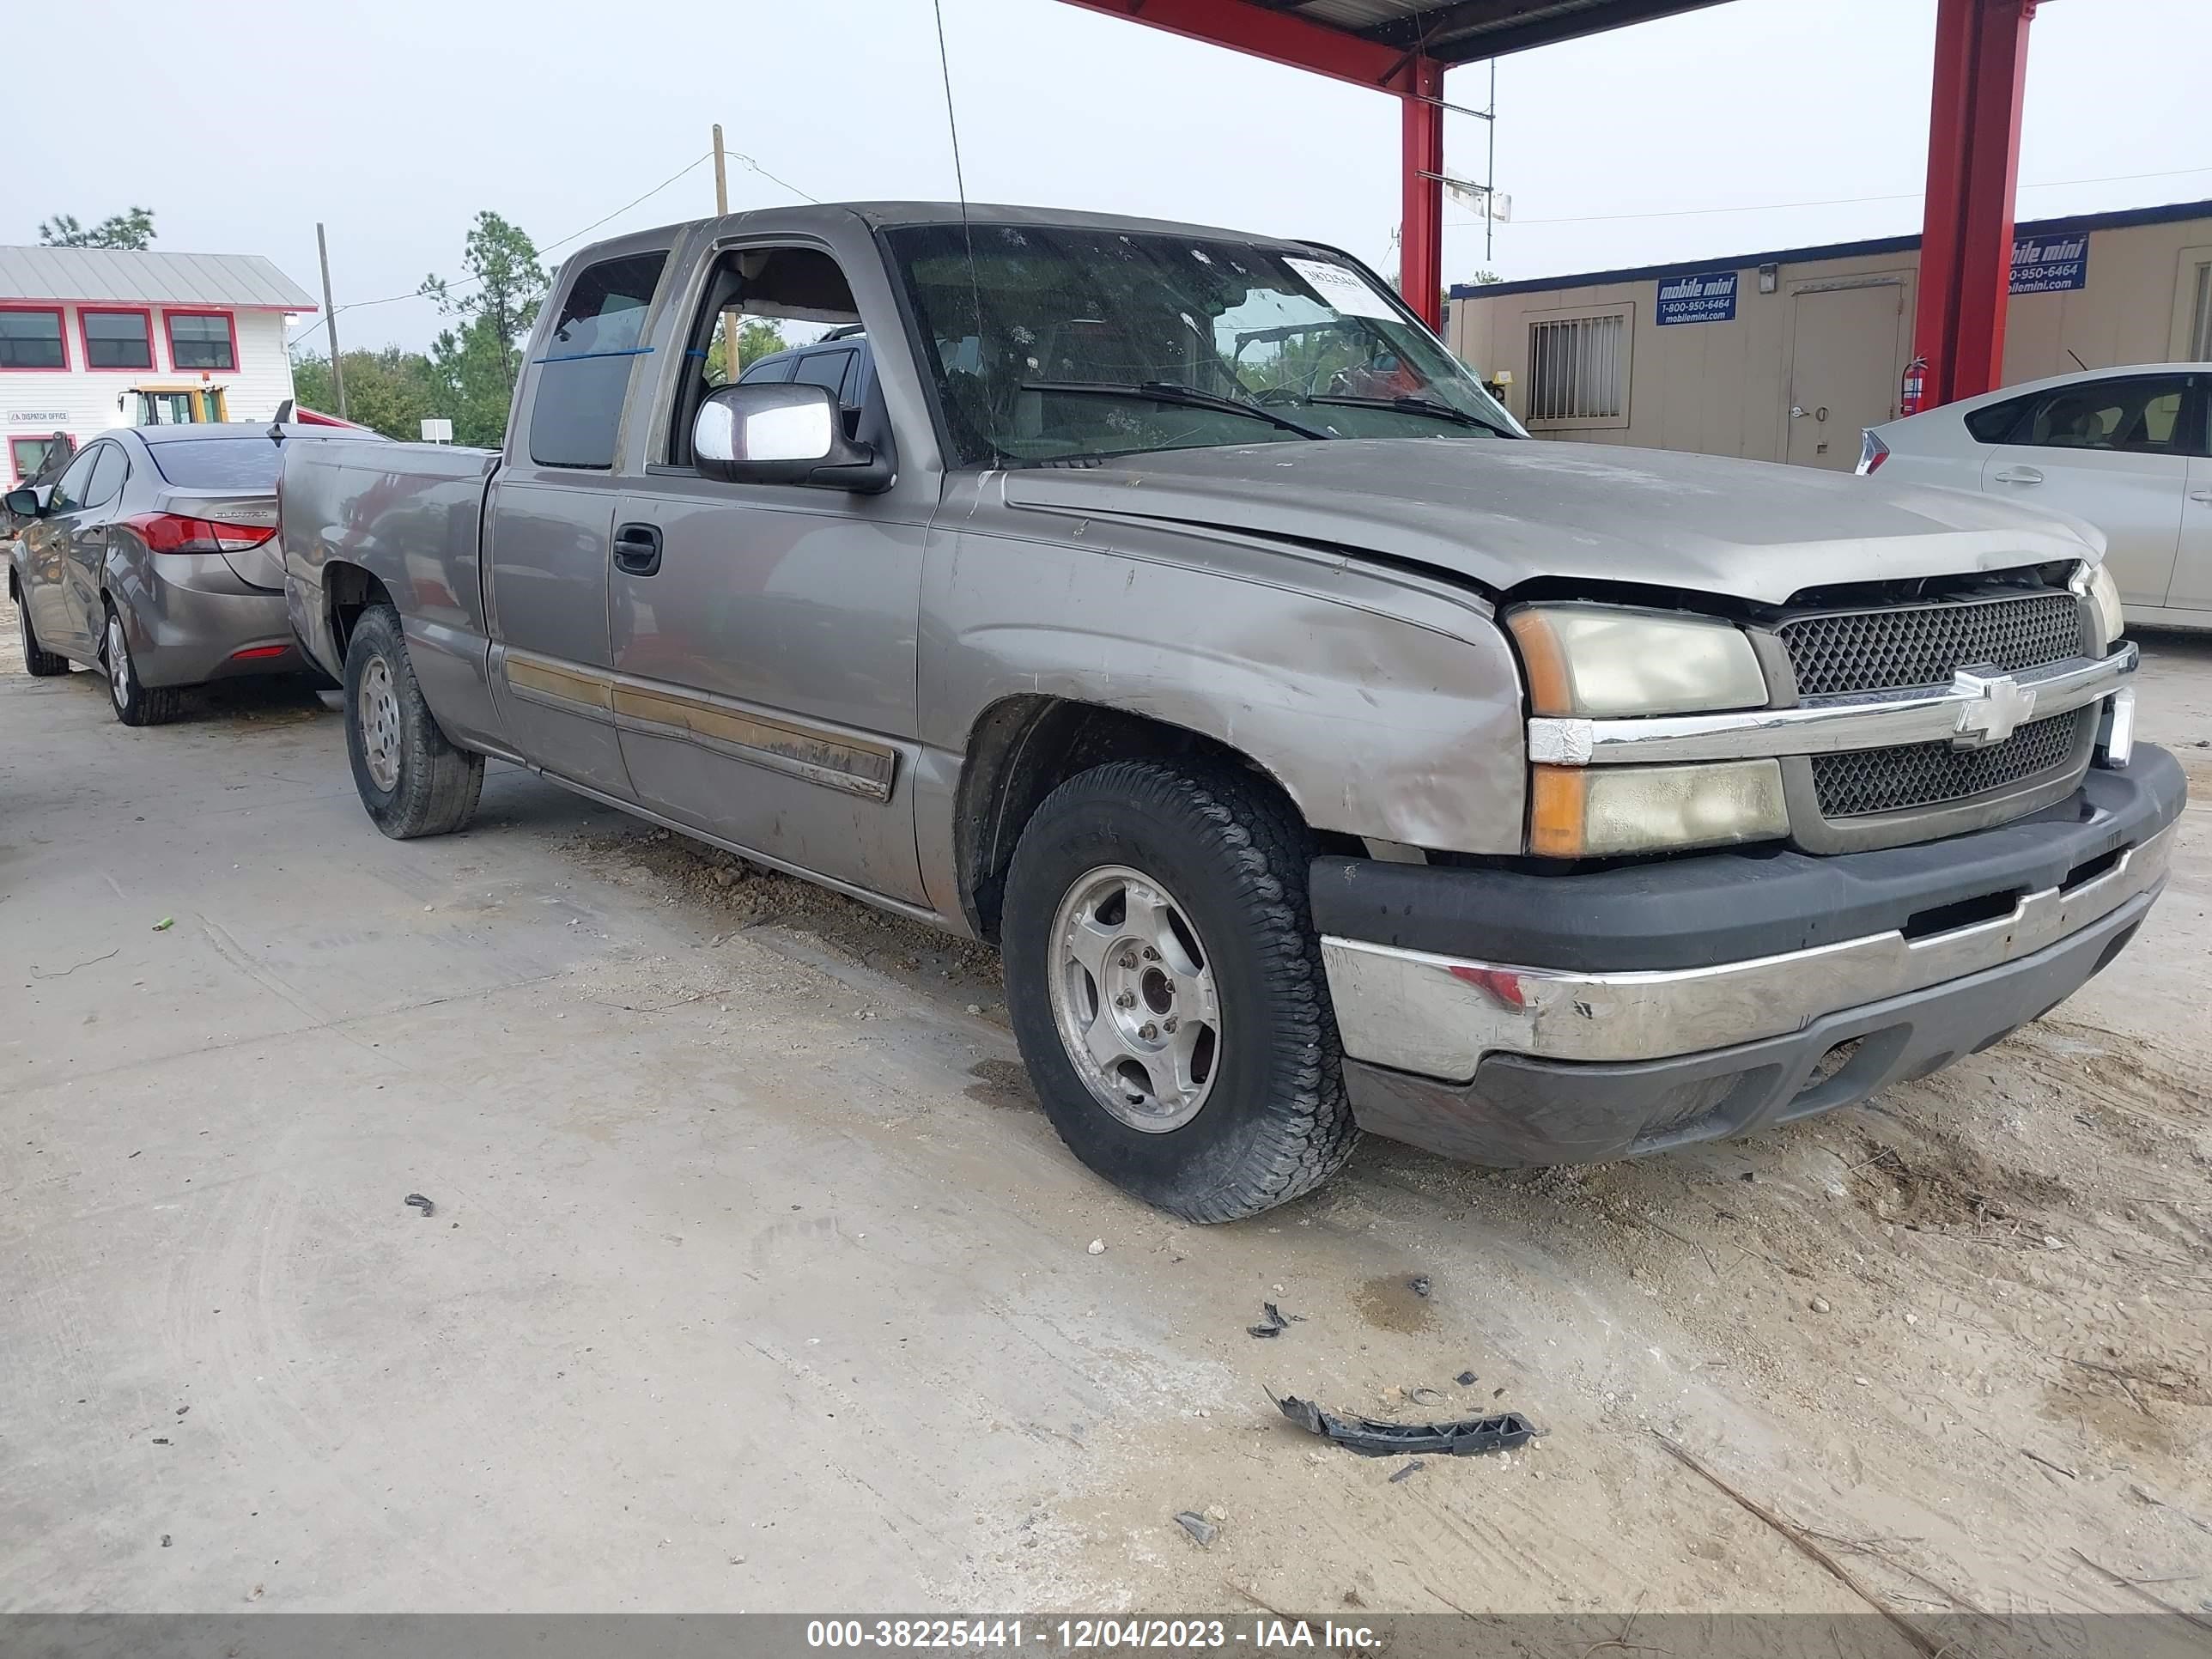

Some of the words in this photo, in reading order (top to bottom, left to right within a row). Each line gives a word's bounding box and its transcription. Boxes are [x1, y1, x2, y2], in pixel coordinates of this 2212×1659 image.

[2010, 240, 2041, 264] bile
[2041, 239, 2085, 261] mini
[2009, 264, 2077, 281] 0-950-6464
[1660, 277, 1703, 300] mobile
[1704, 277, 1735, 295] mini
[2009, 280, 2071, 293] ilemini.com
[1662, 299, 1730, 313] 1-800-950-6464
[1665, 312, 1725, 323] mobilemini.com
